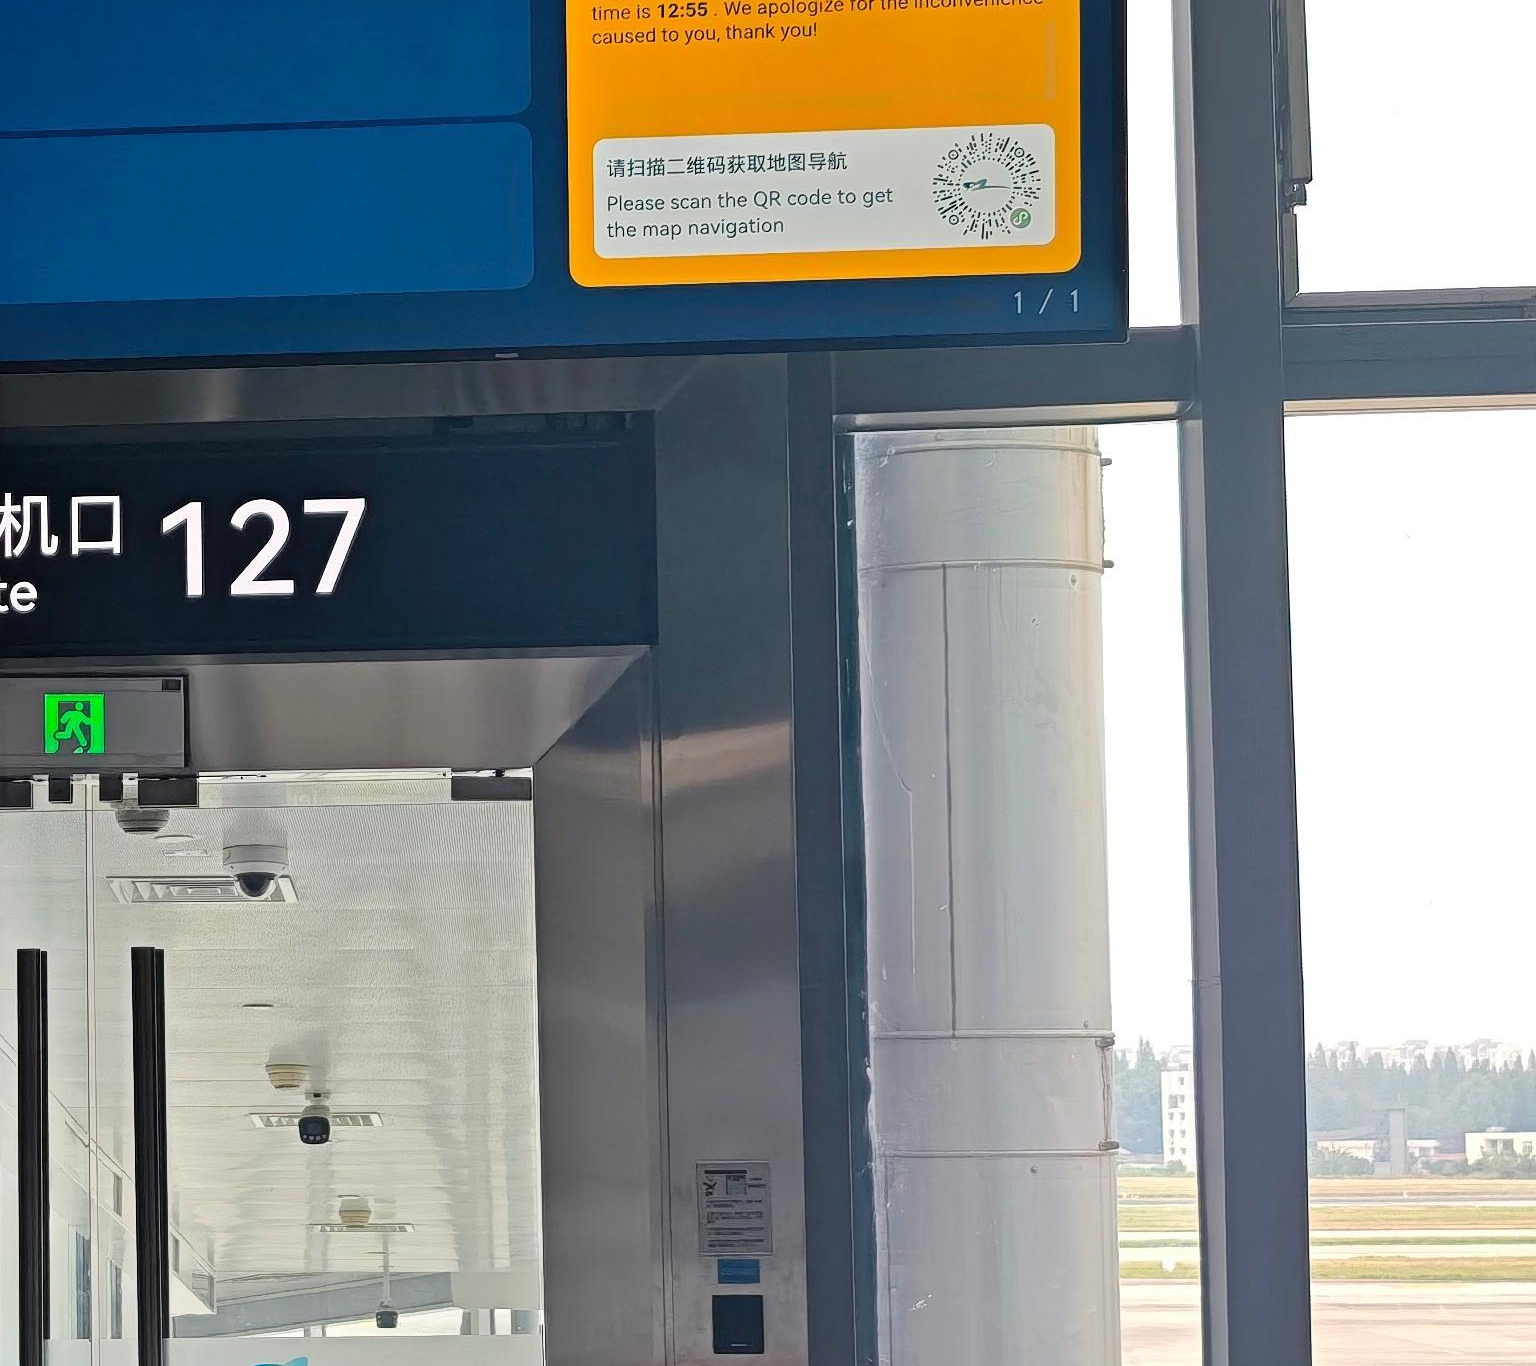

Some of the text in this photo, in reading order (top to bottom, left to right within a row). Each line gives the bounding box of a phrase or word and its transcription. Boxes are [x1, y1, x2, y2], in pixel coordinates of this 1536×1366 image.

[591, 6, 631, 21] time
[636, 4, 651, 20] is
[656, 2, 709, 19] 12:55
[723, 0, 752, 16] We
[591, 21, 817, 46] caused to you, thank you!
[606, 151, 848, 178] 请扫描二维码获取地图导航
[607, 188, 893, 212] Please scan the QR code to get
[606, 217, 784, 241] the map navigation
[162, 497, 366, 598] 127
